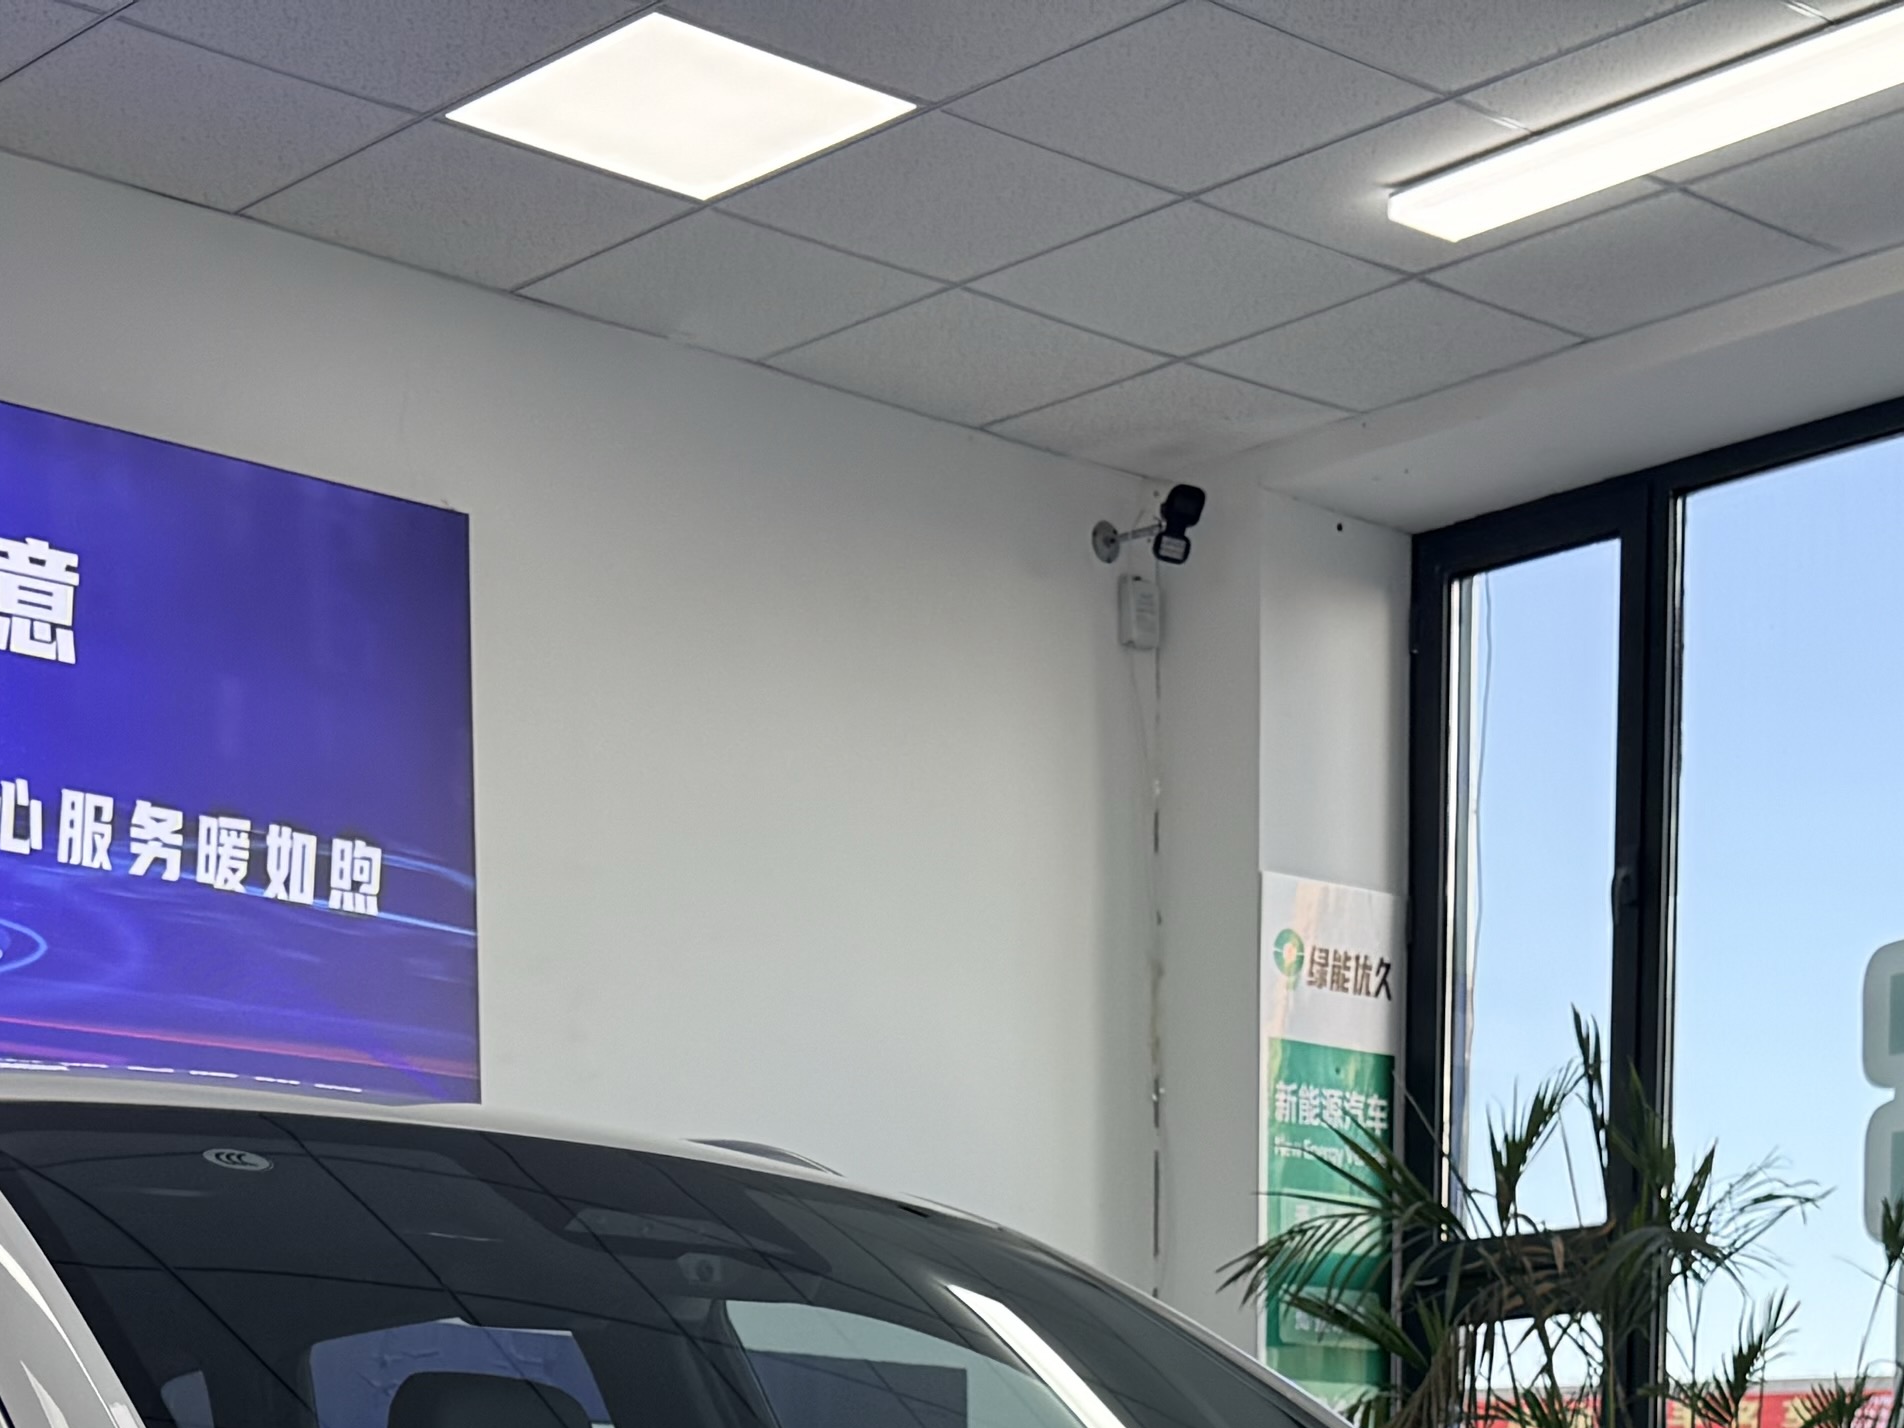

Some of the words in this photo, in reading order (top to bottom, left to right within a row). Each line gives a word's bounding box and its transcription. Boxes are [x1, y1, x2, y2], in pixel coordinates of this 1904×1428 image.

[1306, 945, 1392, 1001] 绿能优久
[1274, 1080, 1389, 1137] 新能源汽车
